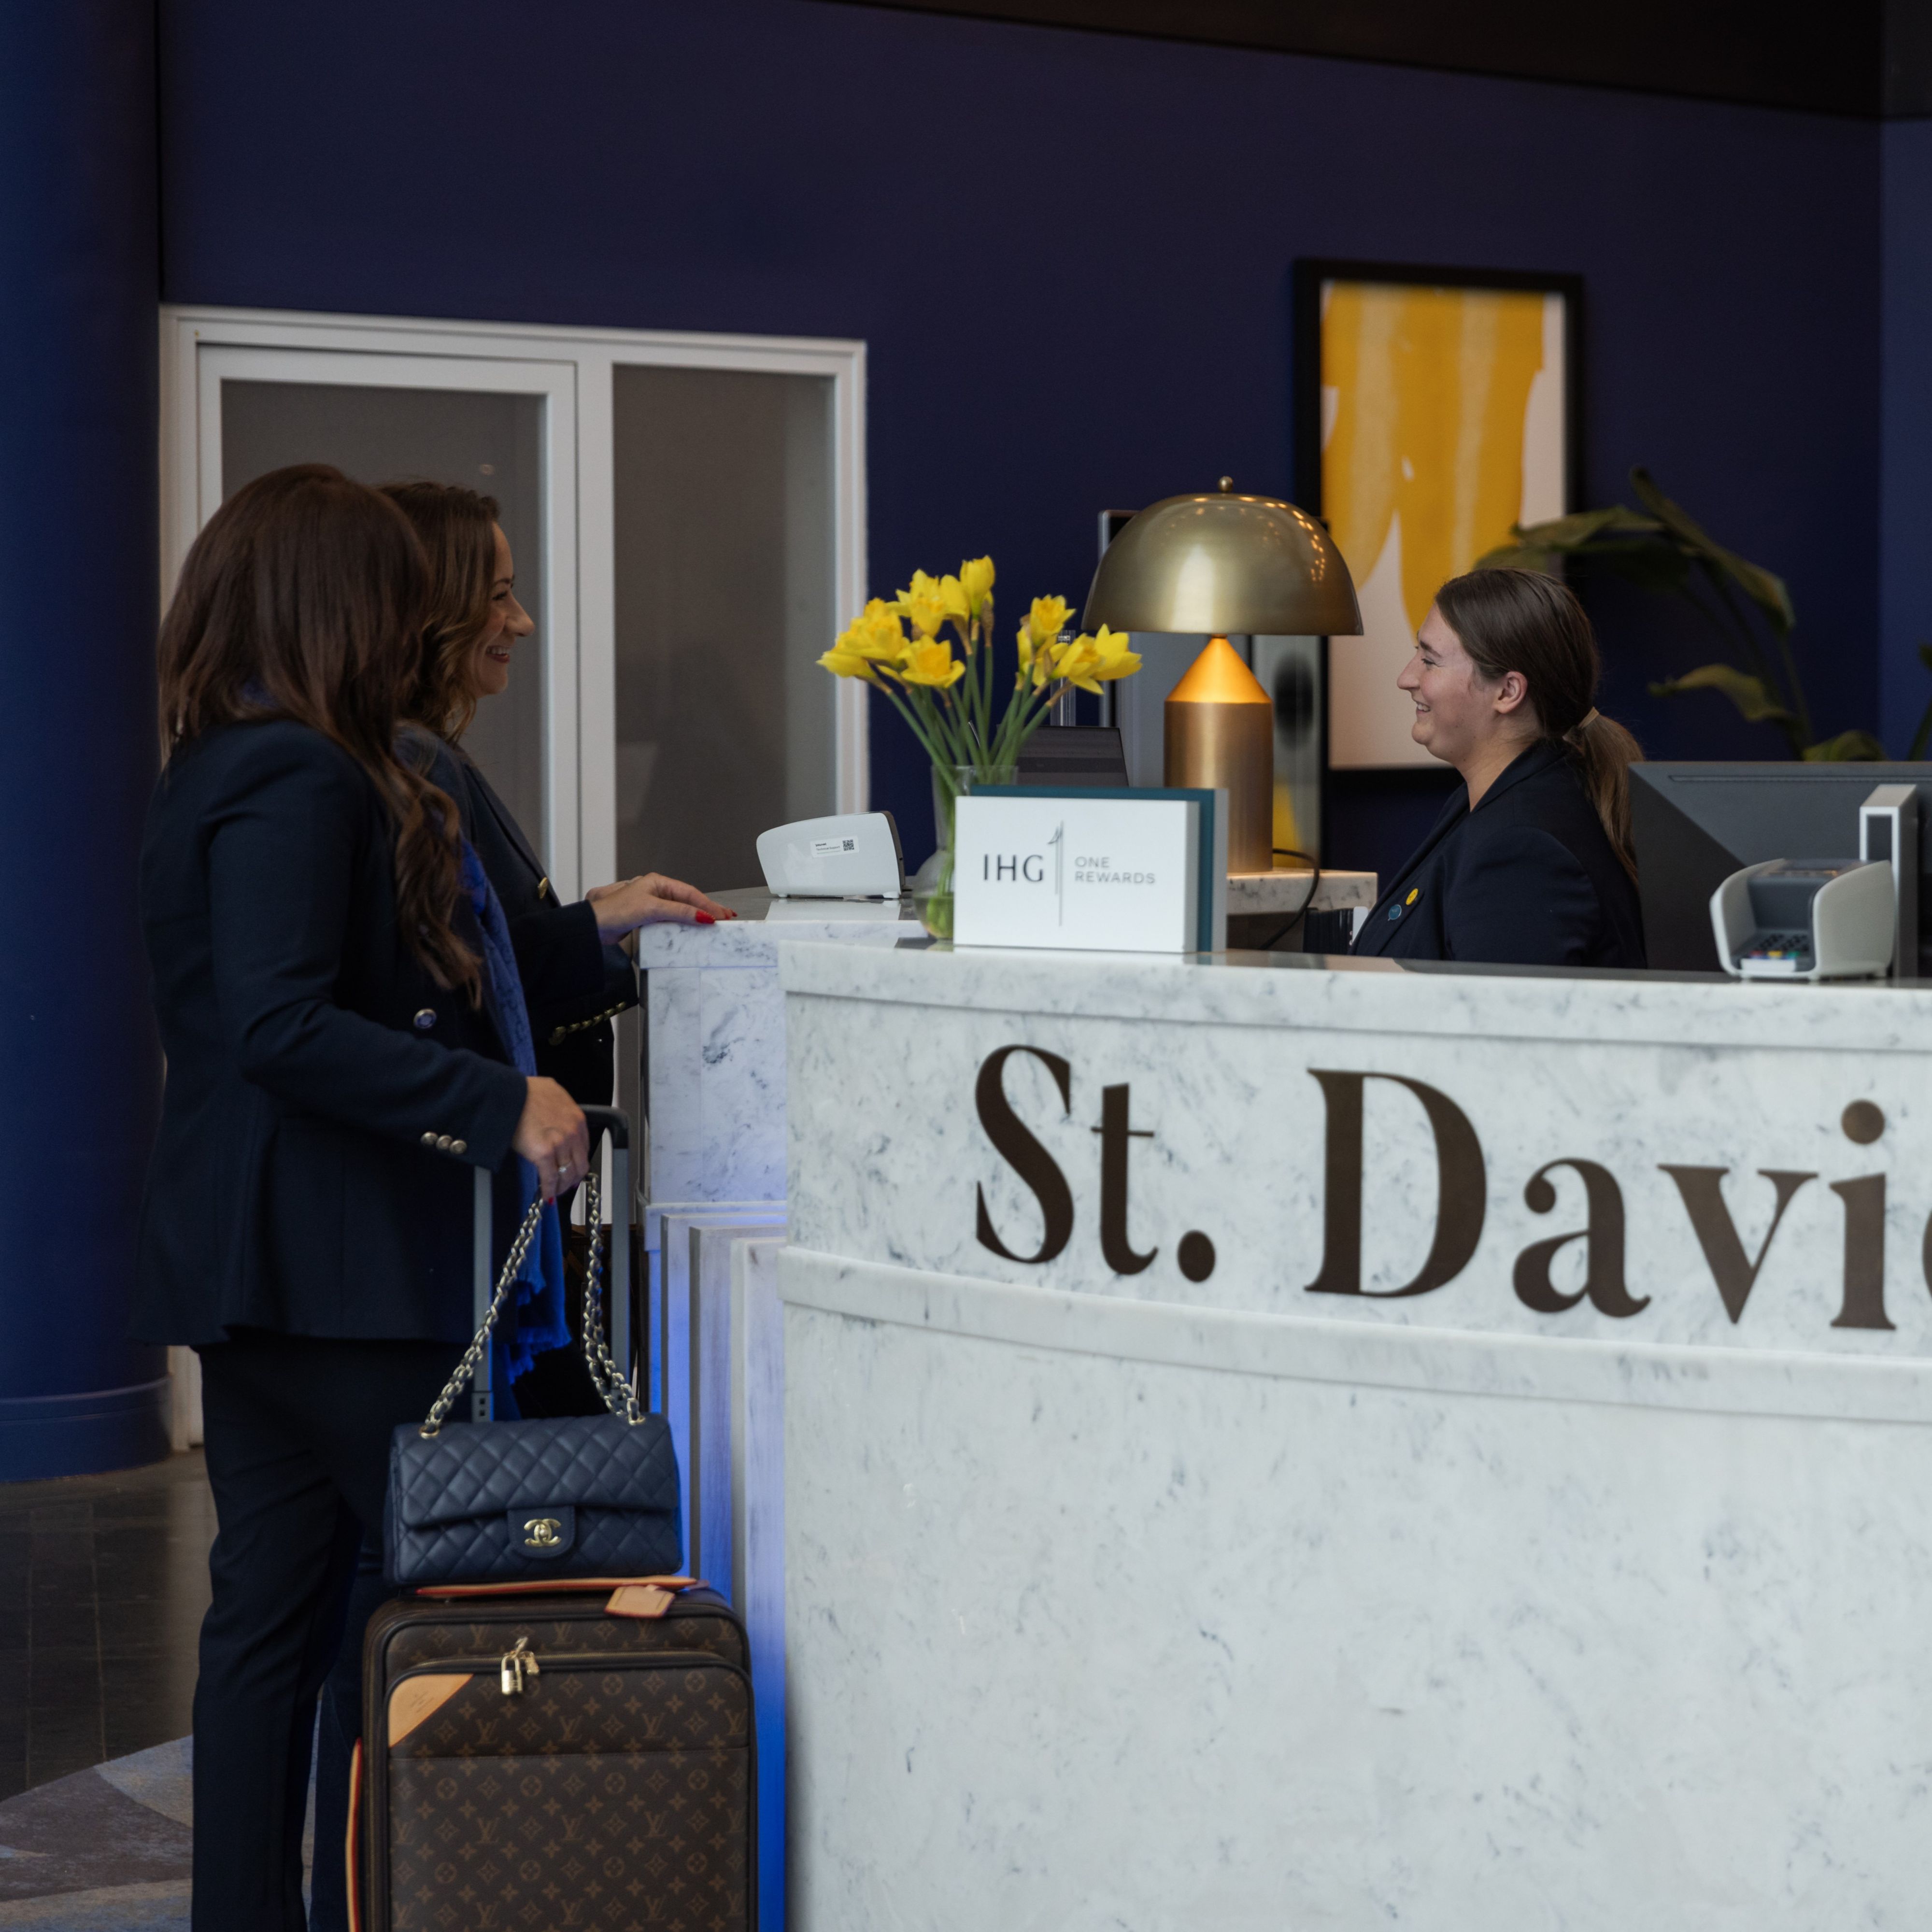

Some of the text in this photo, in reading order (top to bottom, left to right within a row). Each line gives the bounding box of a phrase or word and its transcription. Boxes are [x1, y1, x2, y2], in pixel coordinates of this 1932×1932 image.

[983, 853, 1044, 882] IHG
[1075, 856, 1110, 868] ONE
[1075, 871, 1156, 884] REWARDS
[974, 1044, 1932, 1331] St. Davi
